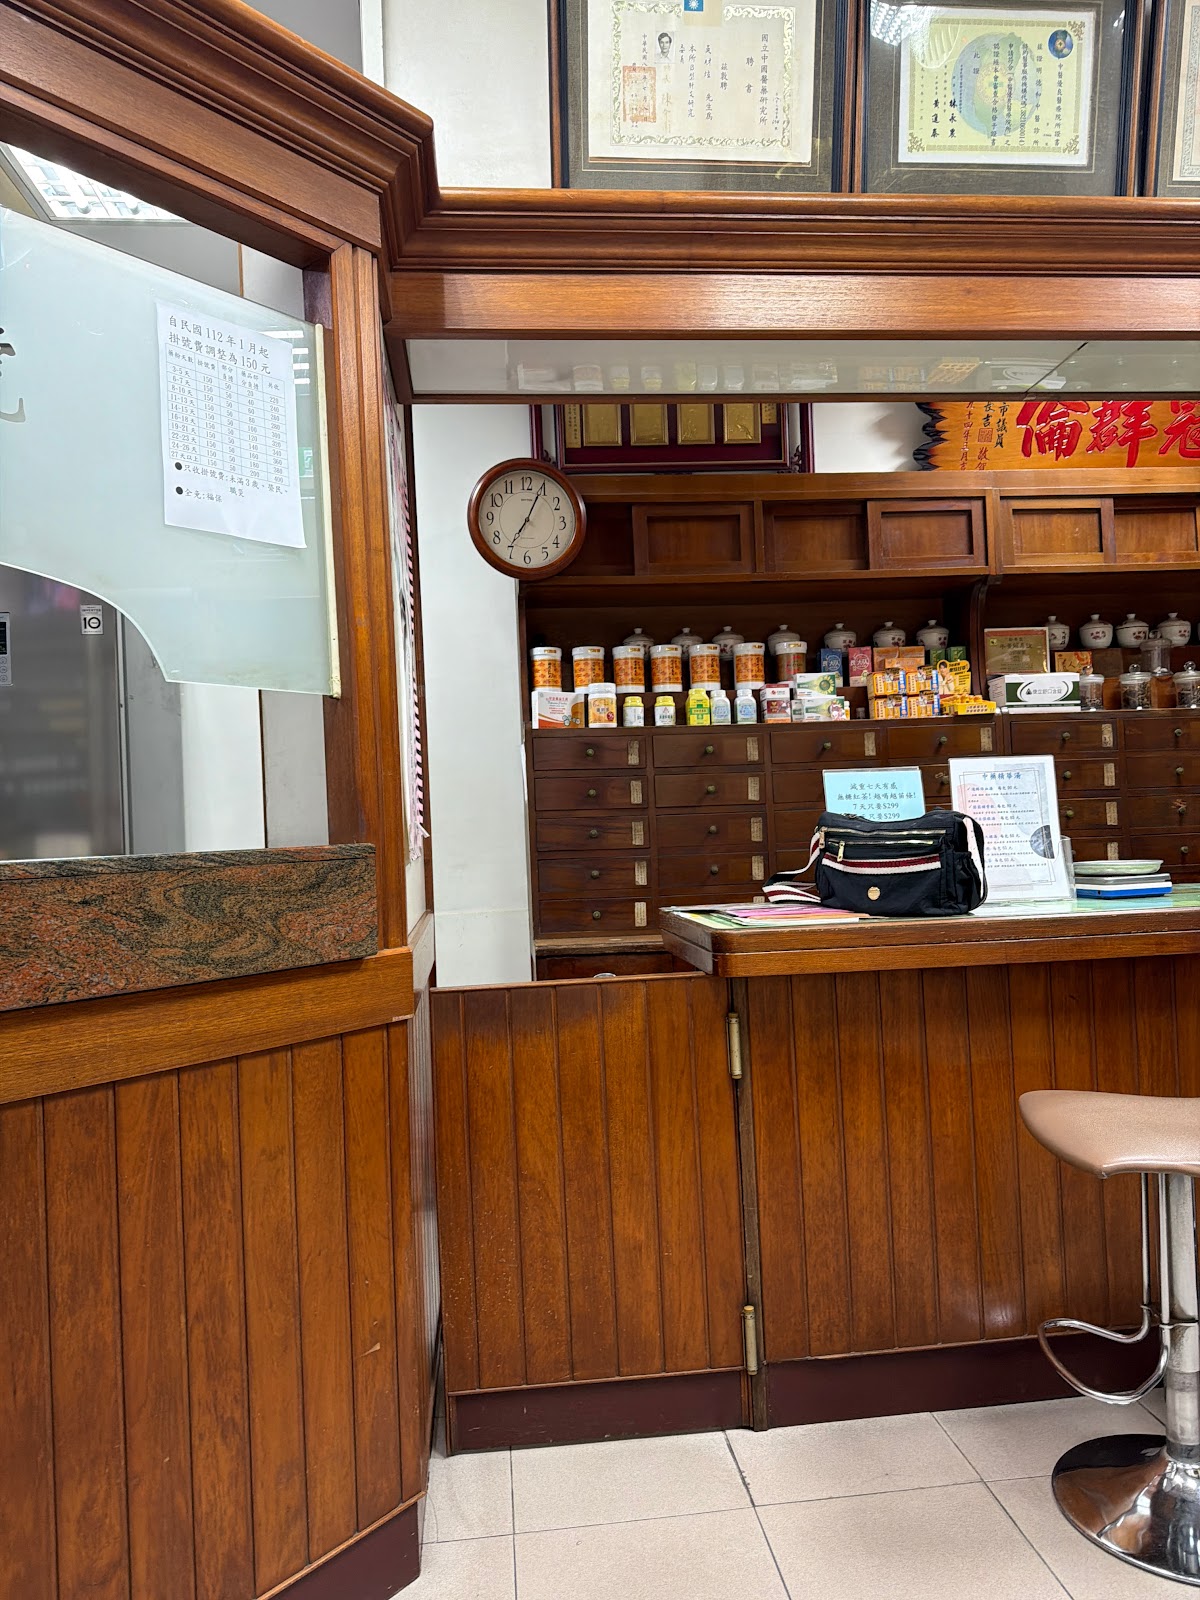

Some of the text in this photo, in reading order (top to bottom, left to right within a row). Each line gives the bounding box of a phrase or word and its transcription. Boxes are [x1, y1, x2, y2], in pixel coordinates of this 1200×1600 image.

[973, 51, 981, 75] 此證
[760, 34, 769, 126] 國立中國醫藥研究所
[1054, 62, 1063, 147] 中醫優良醫療院所證書
[203, 376, 212, 384] 150
[224, 382, 232, 390] 50
[203, 385, 213, 393] 150
[204, 394, 213, 402] 150
[226, 400, 233, 408] 50
[204, 403, 214, 411] 150
[226, 410, 233, 418] 50
[205, 412, 215, 421] 150
[227, 418, 234, 426] 50
[205, 421, 215, 430] 150
[228, 428, 234, 436] 50
[206, 430, 215, 439] 150
[206, 440, 216, 448] 150
[228, 446, 235, 454] 50
[207, 449, 217, 458] 150
[207, 458, 217, 467] 150
[229, 464, 236, 472] 50
[504, 479, 514, 494] 11
[521, 476, 533, 491] 12
[490, 492, 504, 508] 10
[552, 496, 561, 511] 2
[486, 511, 495, 526] 9
[559, 516, 567, 531] 3
[492, 530, 501, 545] 8
[552, 535, 560, 549] 4
[507, 545, 514, 560] 7
[523, 550, 532, 565] 6
[541, 546, 549, 561] 5
[83, 616, 101, 630] 10
[850, 782, 898, 791] 減重七天有感
